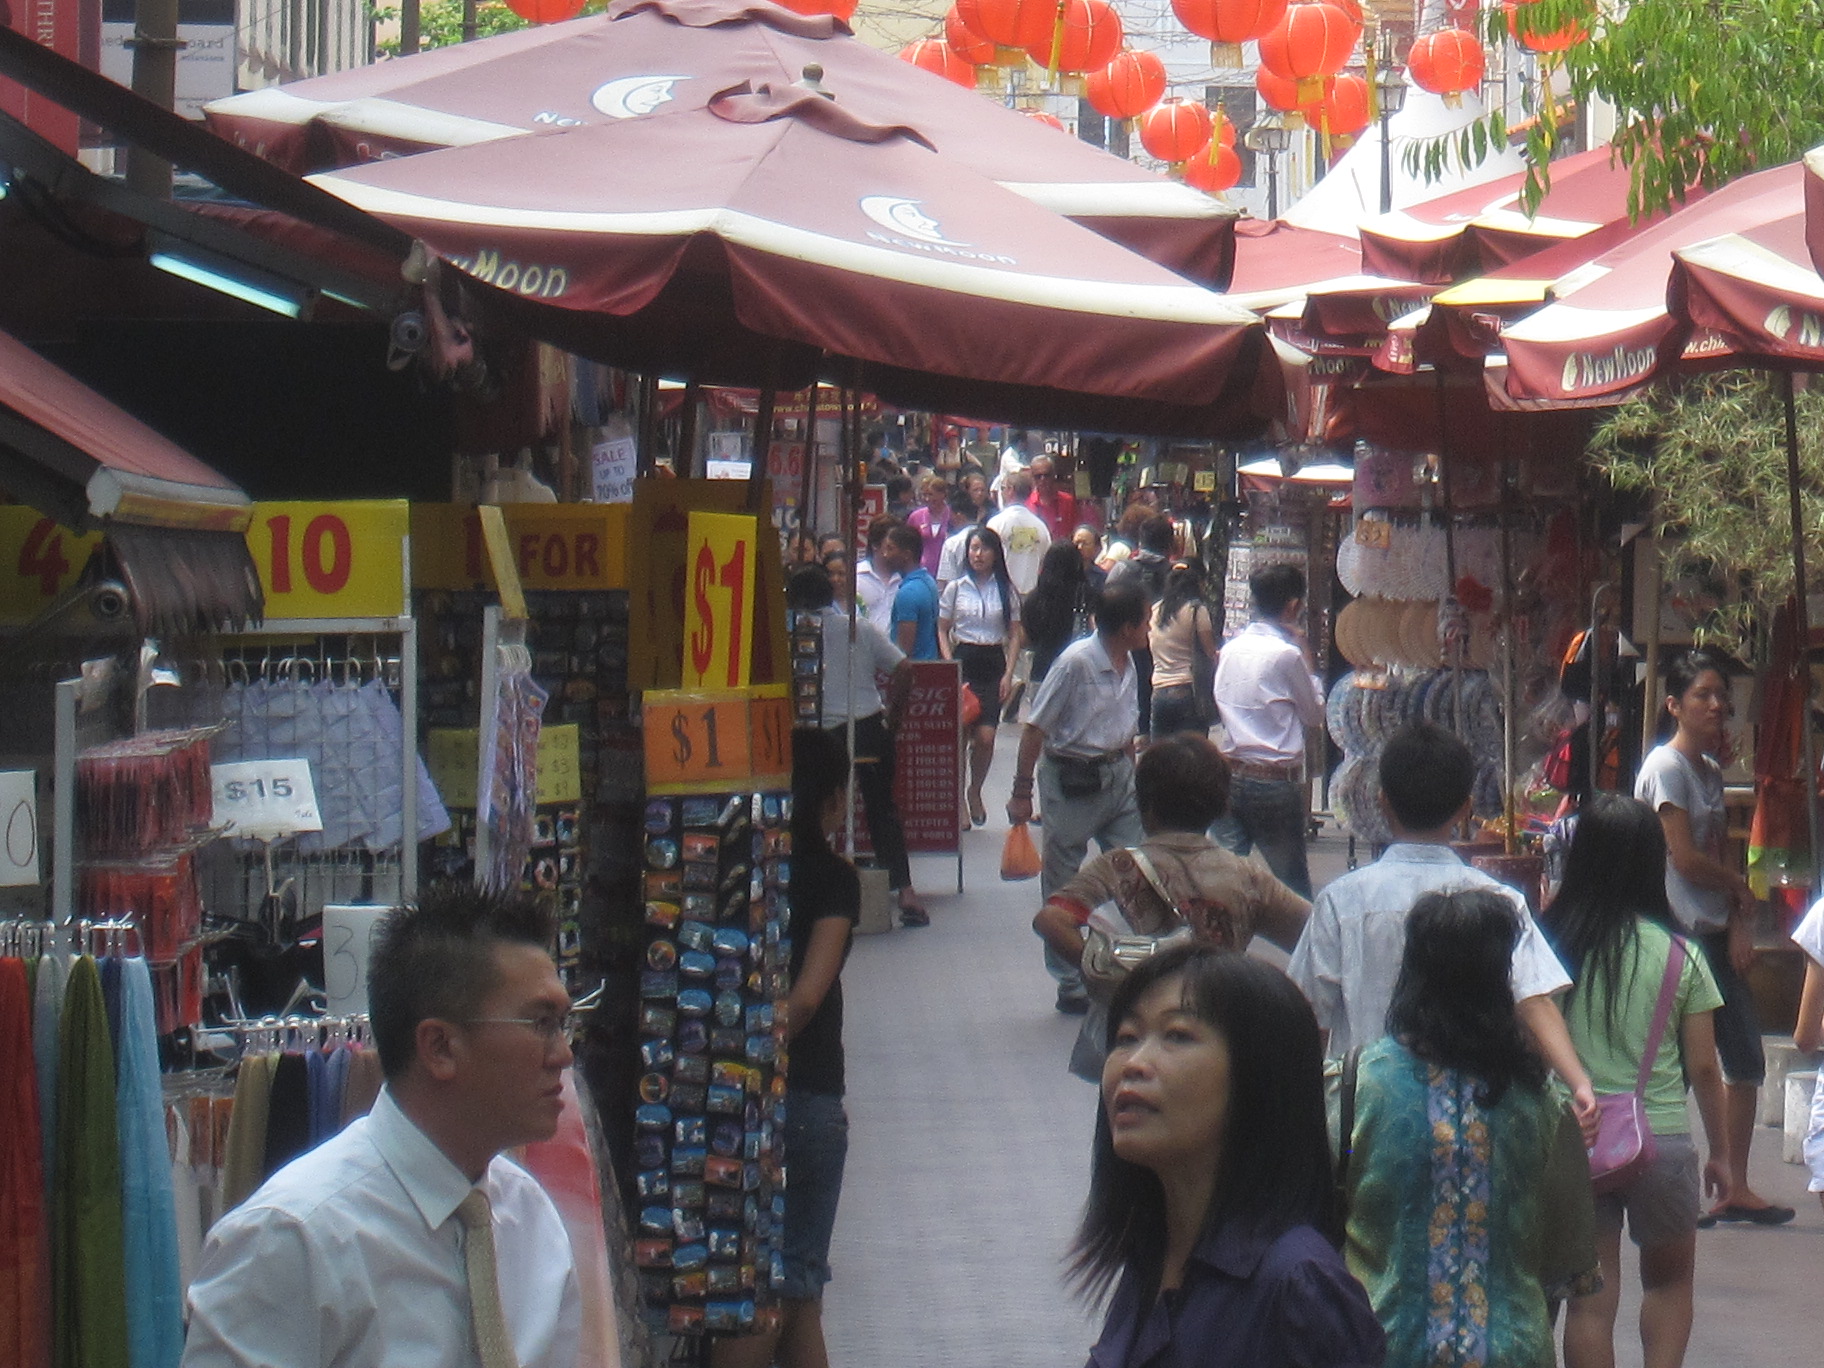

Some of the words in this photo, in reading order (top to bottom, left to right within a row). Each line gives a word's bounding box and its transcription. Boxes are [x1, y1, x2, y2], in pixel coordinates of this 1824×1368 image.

[266, 513, 353, 595] 10
[519, 532, 601, 578] FOR
[690, 536, 747, 688] $1
[670, 705, 725, 771] $1
[223, 778, 295, 802] $15
